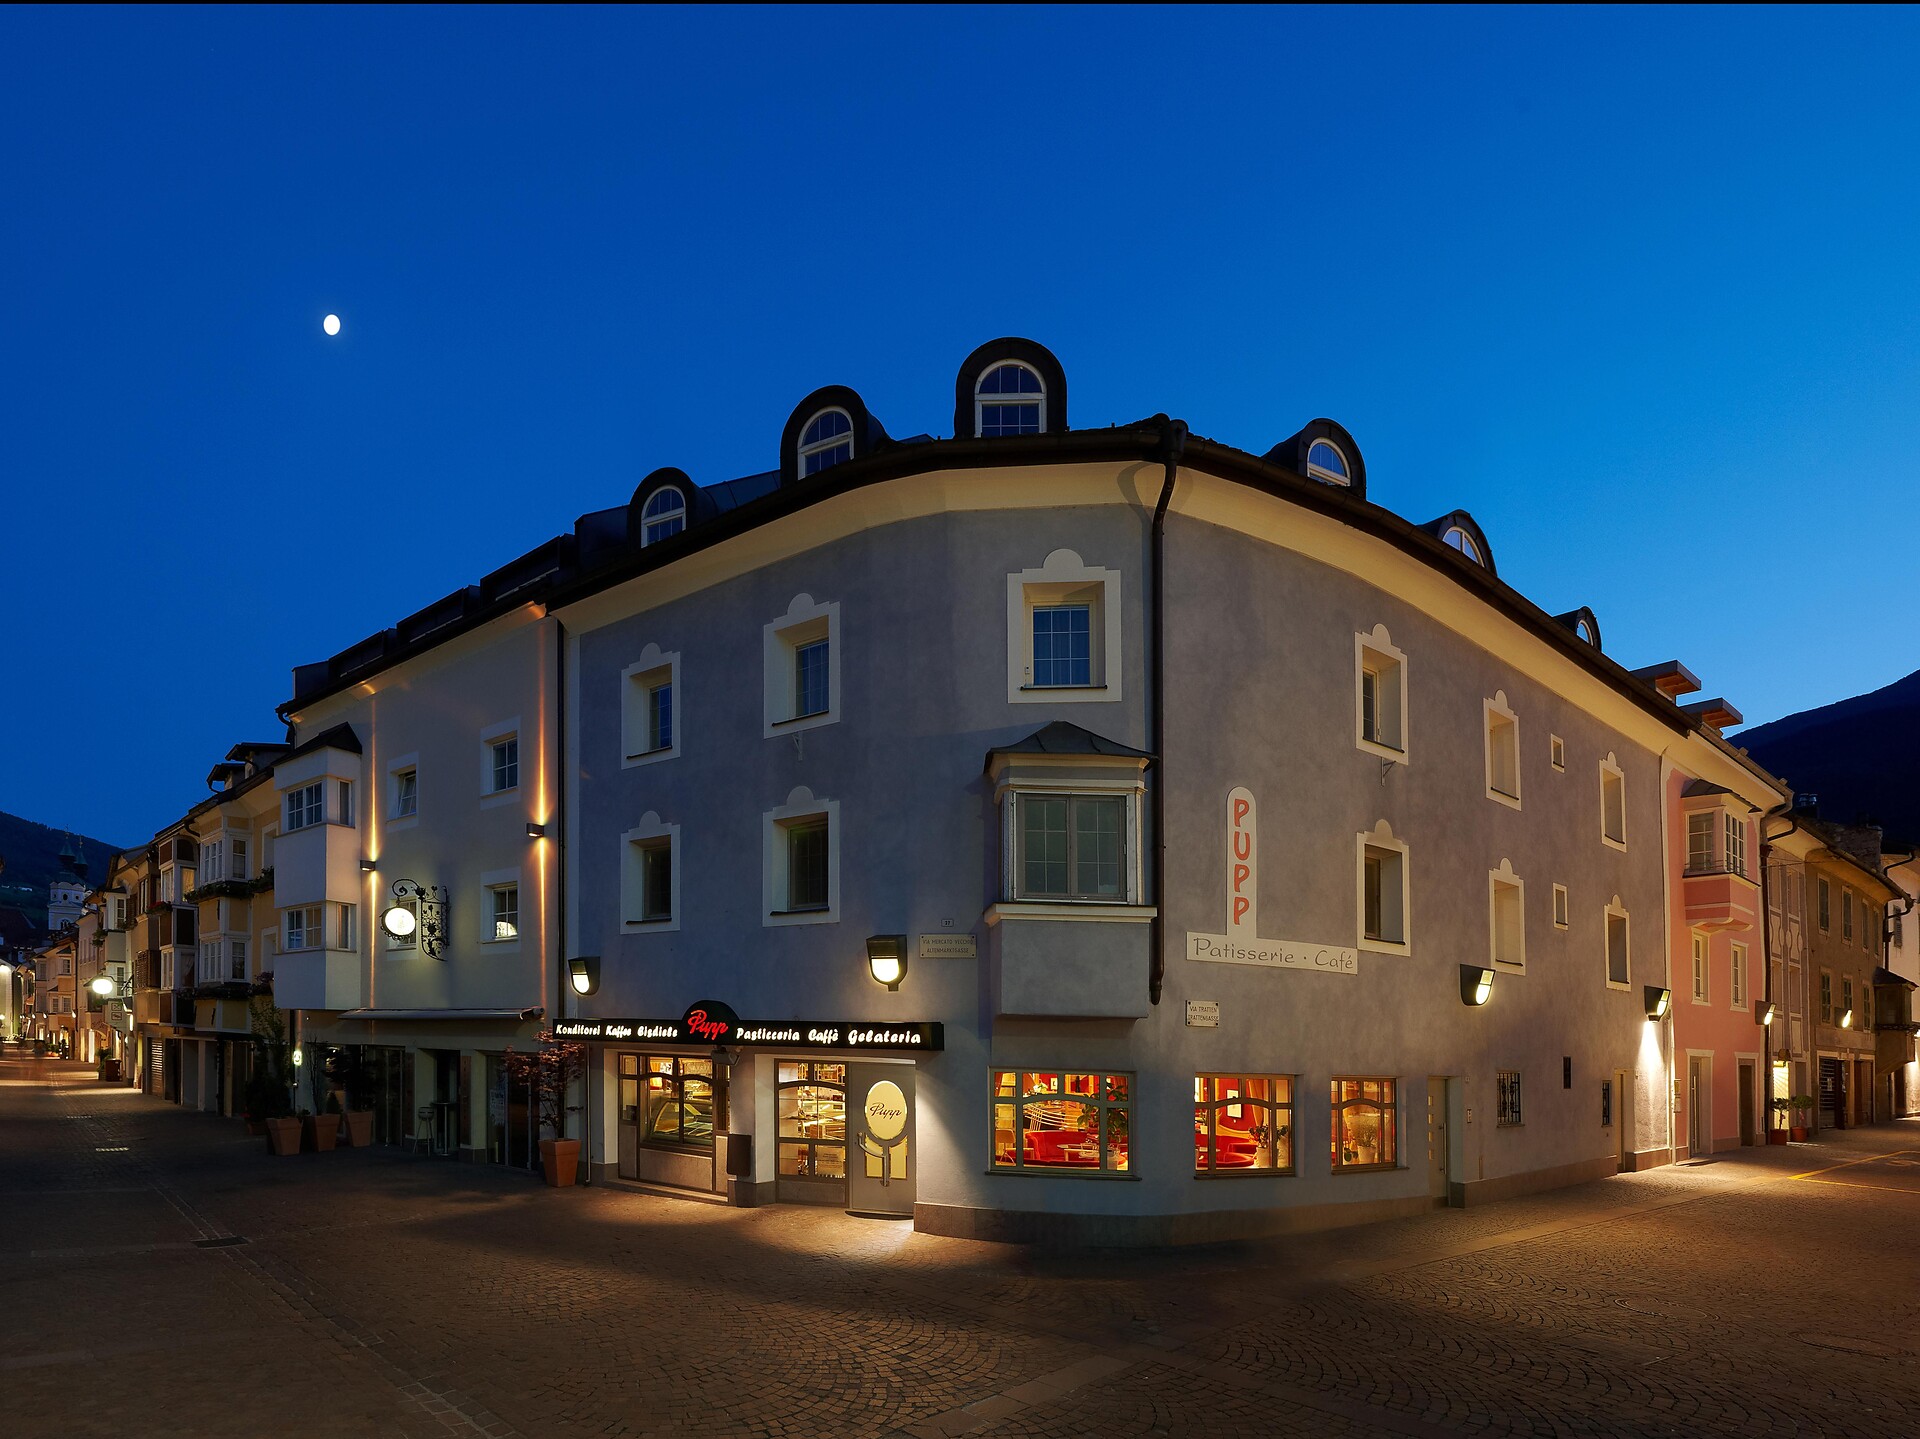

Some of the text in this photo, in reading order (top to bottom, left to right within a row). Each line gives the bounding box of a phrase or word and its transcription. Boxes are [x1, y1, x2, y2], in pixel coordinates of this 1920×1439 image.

[1233, 798, 1251, 926] PUPP
[1193, 937, 1353, 971] Patisserie Café
[555, 1023, 678, 1038] Konditorei Kaffee Eisdiele
[688, 1009, 729, 1041] Pupp
[736, 1027, 922, 1045] Pasticceria Caffè Gelateria
[869, 1102, 902, 1120] Pupp
